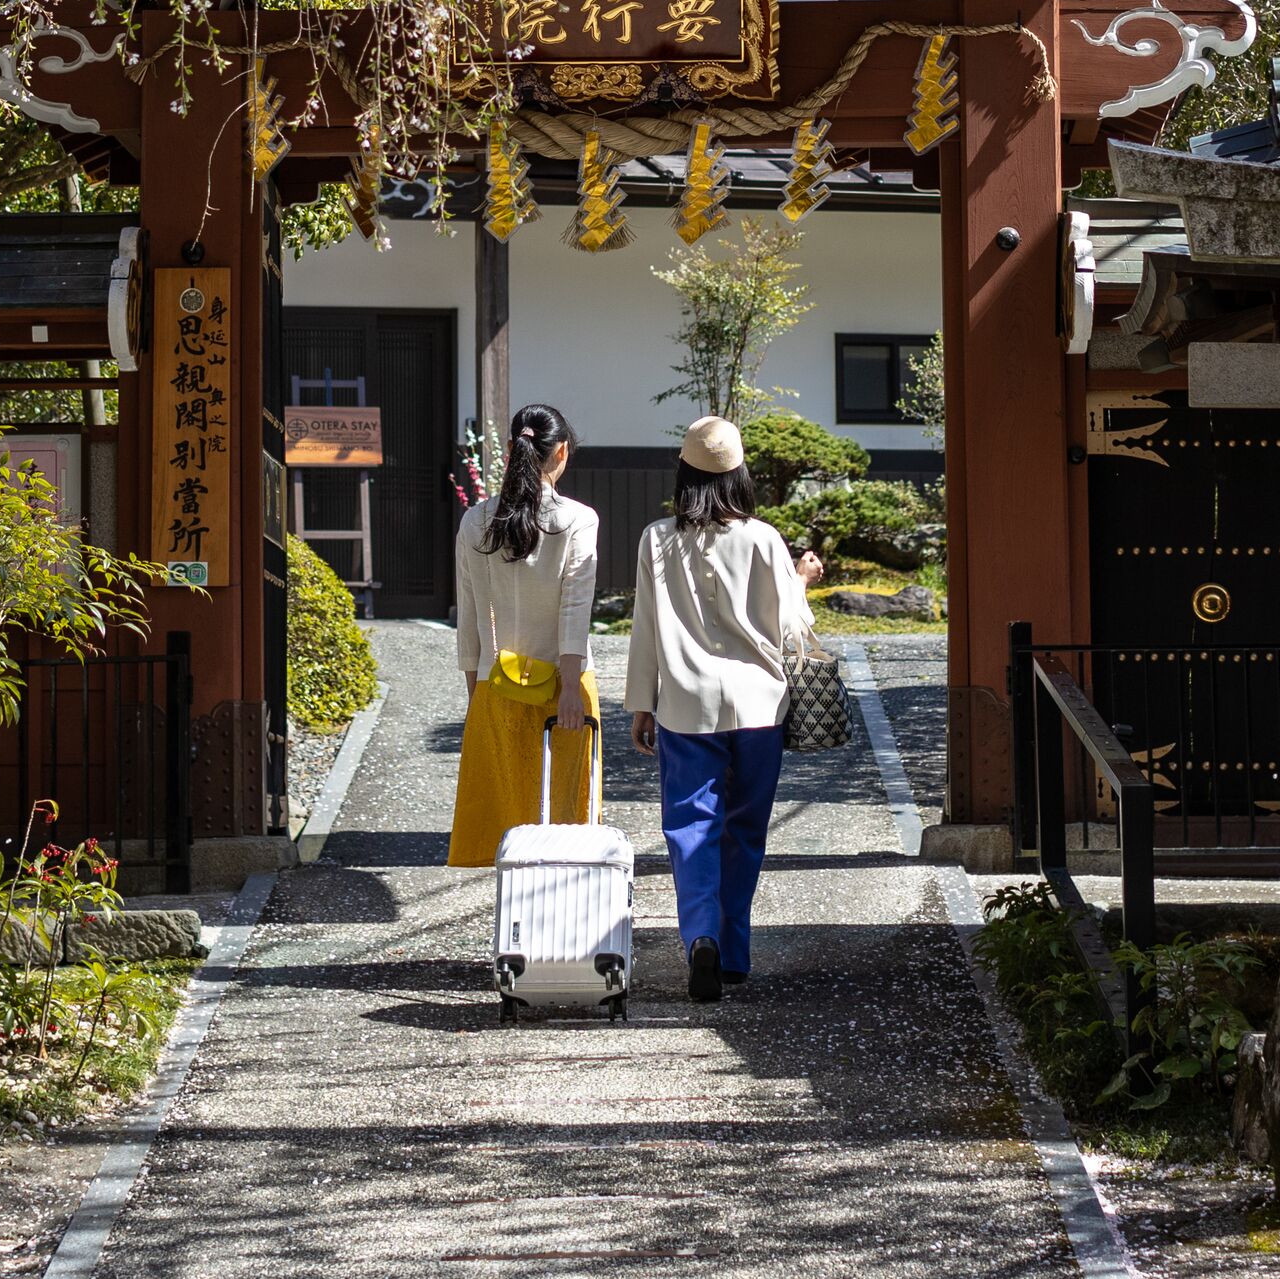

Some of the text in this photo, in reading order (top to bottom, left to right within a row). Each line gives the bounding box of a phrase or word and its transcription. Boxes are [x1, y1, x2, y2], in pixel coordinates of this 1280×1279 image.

[168, 315, 212, 560] 思親閣別當所
[311, 421, 377, 431] OTERA STAY
